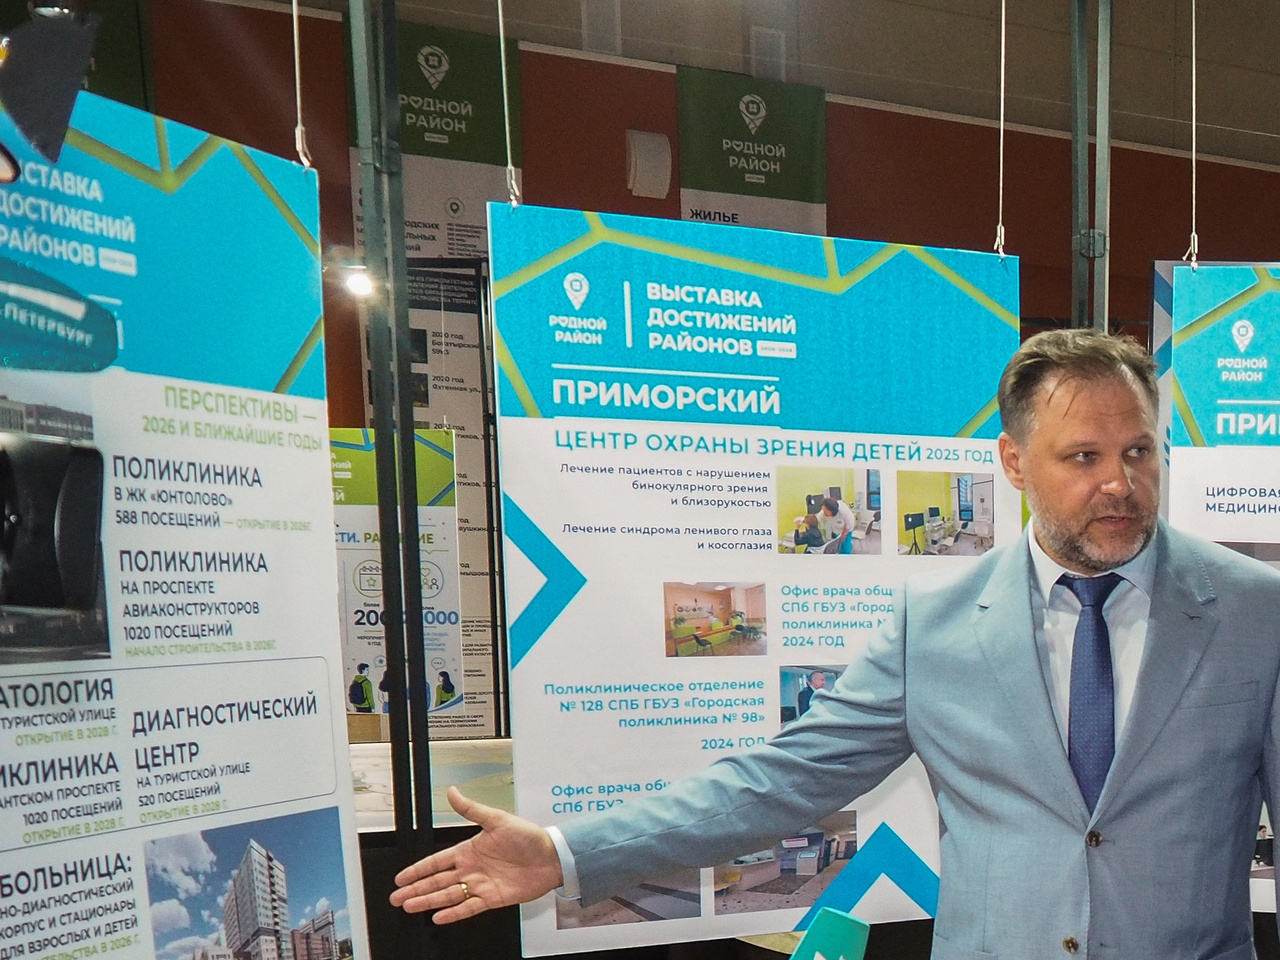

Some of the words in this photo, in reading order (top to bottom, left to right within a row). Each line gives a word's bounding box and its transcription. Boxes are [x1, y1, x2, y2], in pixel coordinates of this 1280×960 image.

[406, 113, 466, 132] РАЙОН
[729, 156, 780, 173] РАЙОН
[19, 160, 104, 202] СТАВКА
[690, 209, 739, 223] ЖИЛЬЕ
[647, 282, 762, 308] ВЫСТАВКА
[647, 307, 796, 335] ДОСТИЖЕНИЙ
[555, 330, 602, 345] РАЙОН
[649, 331, 752, 355] РАЙОНОВ
[1221, 369, 1263, 382] РАЙОН
[165, 386, 298, 423] ПЕРСПЕКТИВЫ
[553, 378, 780, 414] ПРИМОРСКИЙ
[142, 415, 175, 434] 2026
[180, 420, 190, 434] И
[194, 421, 283, 446] БЛИЖАЙШИЕ
[288, 431, 322, 451] ГОДЫ
[555, 430, 637, 450] ЦЕНТР
[646, 433, 749, 455] ОХРАНЫ
[757, 438, 845, 458] ЗРЕНИЯ
[852, 442, 921, 462] ДЕТЕЙ
[926, 447, 959, 461] 2025
[965, 449, 993, 464] ГОД
[112, 455, 263, 488] ПОЛИКЛИНИКА
[560, 463, 614, 475] Лечение
[618, 467, 683, 478] пациентов
[686, 469, 692, 477] с
[696, 468, 771, 481] нарушением
[114, 487, 123, 501] В
[126, 487, 146, 501] ЖК
[150, 488, 233, 506] «ЮНТОЛОВО»
[632, 480, 723, 494] бинокулярного
[727, 484, 768, 495] зрения
[671, 498, 678, 506] и
[682, 495, 771, 508] близорукостью
[115, 510, 137, 524] 588
[142, 510, 220, 528] ПОСЕЩЕНИЙ
[562, 524, 616, 534] Лечение
[620, 526, 680, 537] синдрома
[684, 527, 739, 536] ленивого
[742, 527, 772, 537] глаза
[697, 542, 704, 550] и
[708, 541, 772, 551] косоглазия
[119, 550, 269, 573] ПОЛИКЛИНИКА
[121, 581, 139, 595] НА
[143, 580, 215, 595] ПРОСПЕКТЕ
[781, 585, 818, 598] Офис
[823, 587, 860, 598] врача
[865, 585, 893, 596] общ
[123, 601, 260, 618] АВИАКОНСТРУКТОРОВ
[782, 602, 809, 612] СПб
[813, 602, 846, 612] ГБУЗ
[850, 602, 894, 614] «Город
[123, 626, 151, 640] 1020
[155, 620, 233, 640] ПОСЕЩЕНИЙ
[782, 619, 873, 630] поликлиника
[125, 646, 166, 657] НАЧАЛО
[168, 642, 243, 655] СТРОИТЕЛЬСТВА
[782, 636, 814, 647] 2024
[818, 635, 845, 648] ГОД
[544, 681, 684, 696] Поликлиническое
[688, 680, 764, 692] отделение
[560, 701, 576, 712] №
[581, 700, 604, 711] 128
[608, 699, 639, 711] СПБ
[644, 697, 680, 710] ГБУЗ
[684, 696, 764, 709] «Городская
[1, 708, 76, 729] ТУРИСТСКОЙ
[80, 707, 116, 722] УЛИЦЕ
[132, 690, 317, 738] ДИАГНОСТИЧЕСКИЙ
[619, 714, 718, 728] поликлиника
[722, 713, 737, 723] №
[742, 711, 765, 723] 98»
[15, 729, 73, 747] ОТКРЫТИЕ
[77, 728, 83, 739] В
[701, 738, 734, 750] 2024
[135, 741, 200, 773] ЦЕНТР
[137, 777, 151, 788] НА
[154, 764, 217, 786] ТУРИСТСКОЙ
[220, 762, 250, 776] УЛИЦЕ
[57, 780, 121, 799] ПРОСПЕКТЕ
[138, 794, 155, 807] 520
[158, 784, 221, 804] ПОСЕЩЕНИЙ
[551, 784, 593, 798] Офис
[598, 782, 641, 797] врача
[645, 779, 671, 791] об
[23, 811, 48, 826] 1020
[51, 797, 123, 821] ПОСЕЩЕНИЙ
[140, 808, 190, 824] ОТКРЫТИЕ
[193, 806, 198, 816] В
[552, 801, 583, 814] СПб
[23, 824, 82, 844] ОТКРЫТИЕ
[84, 823, 91, 834] В
[0, 853, 132, 898] БОЛЬНИЦА:
[48, 916, 56, 929] И
[59, 898, 136, 926] СТАЦИОНАРЫ
[28, 928, 91, 954] ВЗРОСЛЫХ
[94, 924, 101, 937] И
[104, 914, 138, 936] ДЕТЕЙ
[101, 941, 107, 953] В
